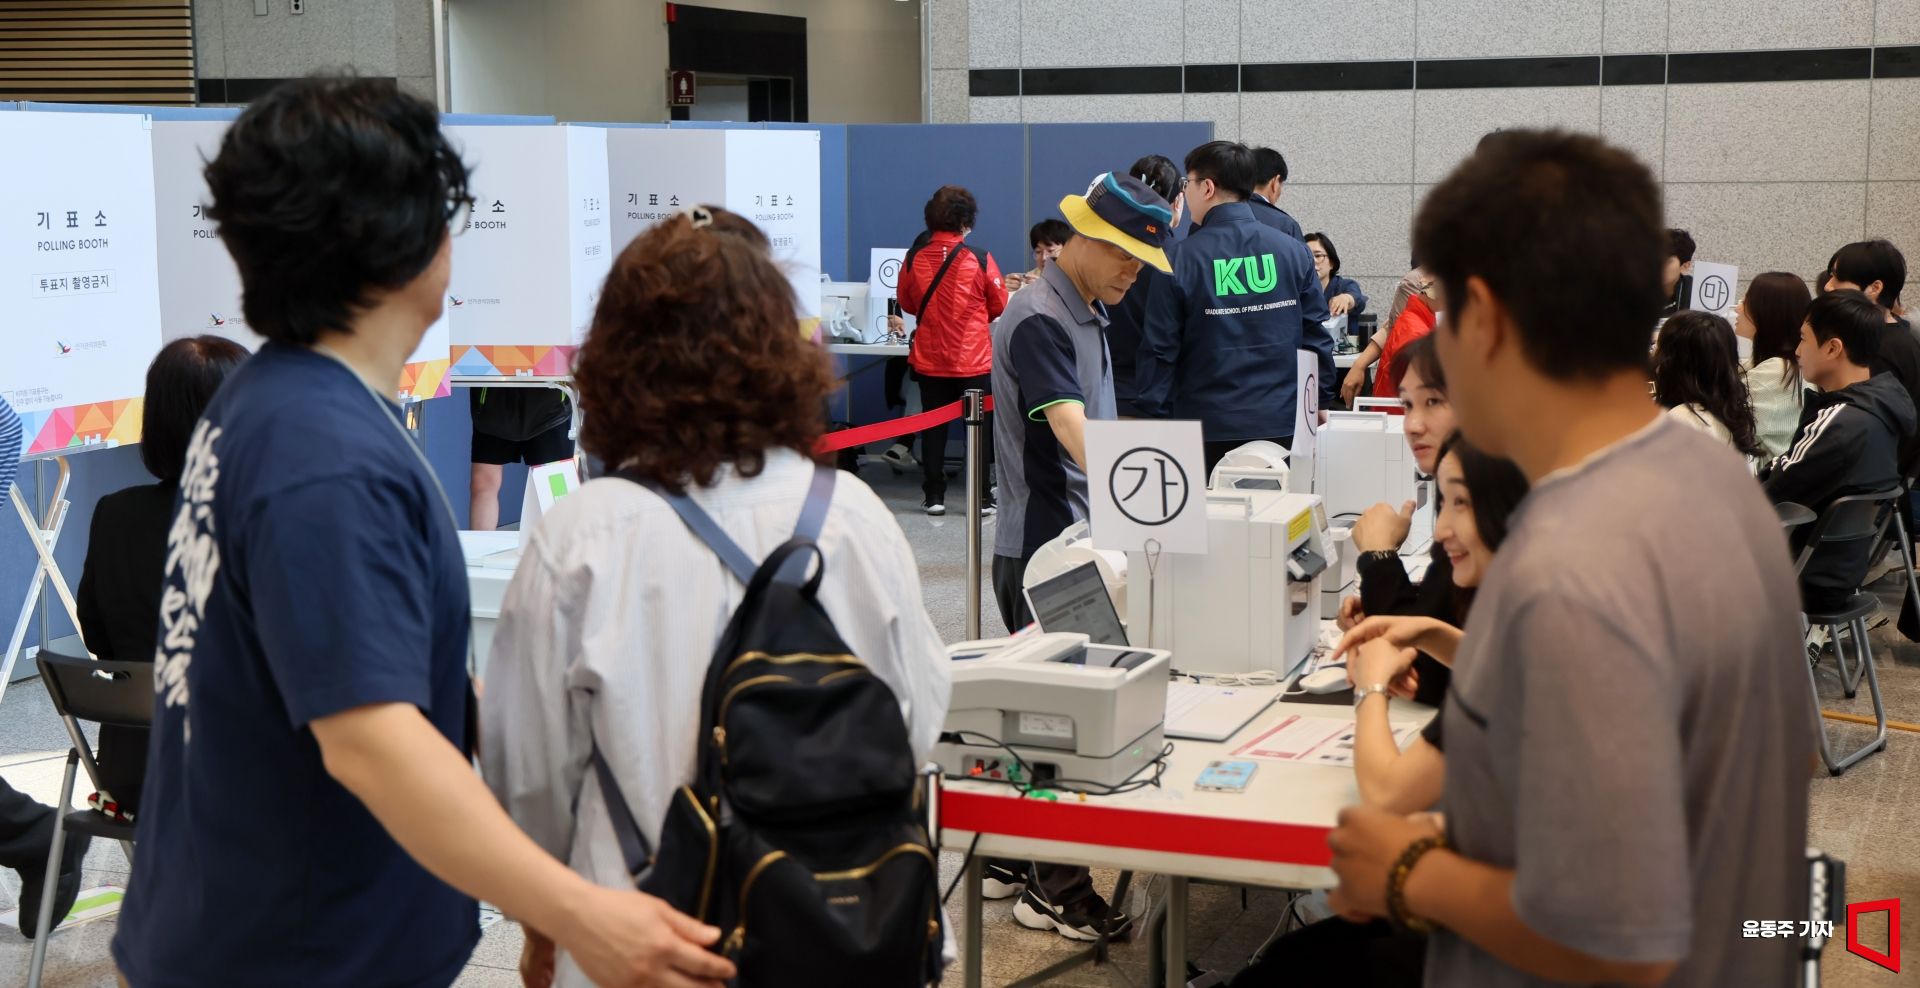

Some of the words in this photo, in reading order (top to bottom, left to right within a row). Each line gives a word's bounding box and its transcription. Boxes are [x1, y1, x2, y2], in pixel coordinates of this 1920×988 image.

[628, 193, 638, 206] 기
[648, 193, 659, 206] 표
[669, 194, 680, 206] 소
[37, 211, 50, 230] 기
[66, 210, 79, 228] 표
[94, 209, 107, 227] 소
[627, 212, 656, 220] POLLING
[474, 220, 507, 230] BOOTH
[37, 239, 76, 252] POLLING
[78, 237, 109, 250] BOOTH
[39, 277, 68, 293] 투표지
[72, 274, 109, 291] 촬영금지
[1213, 253, 1278, 297] KU
[1703, 279, 1727, 309] 마
[1247, 304, 1264, 313] PUBLIC
[1119, 455, 1181, 520] 가
